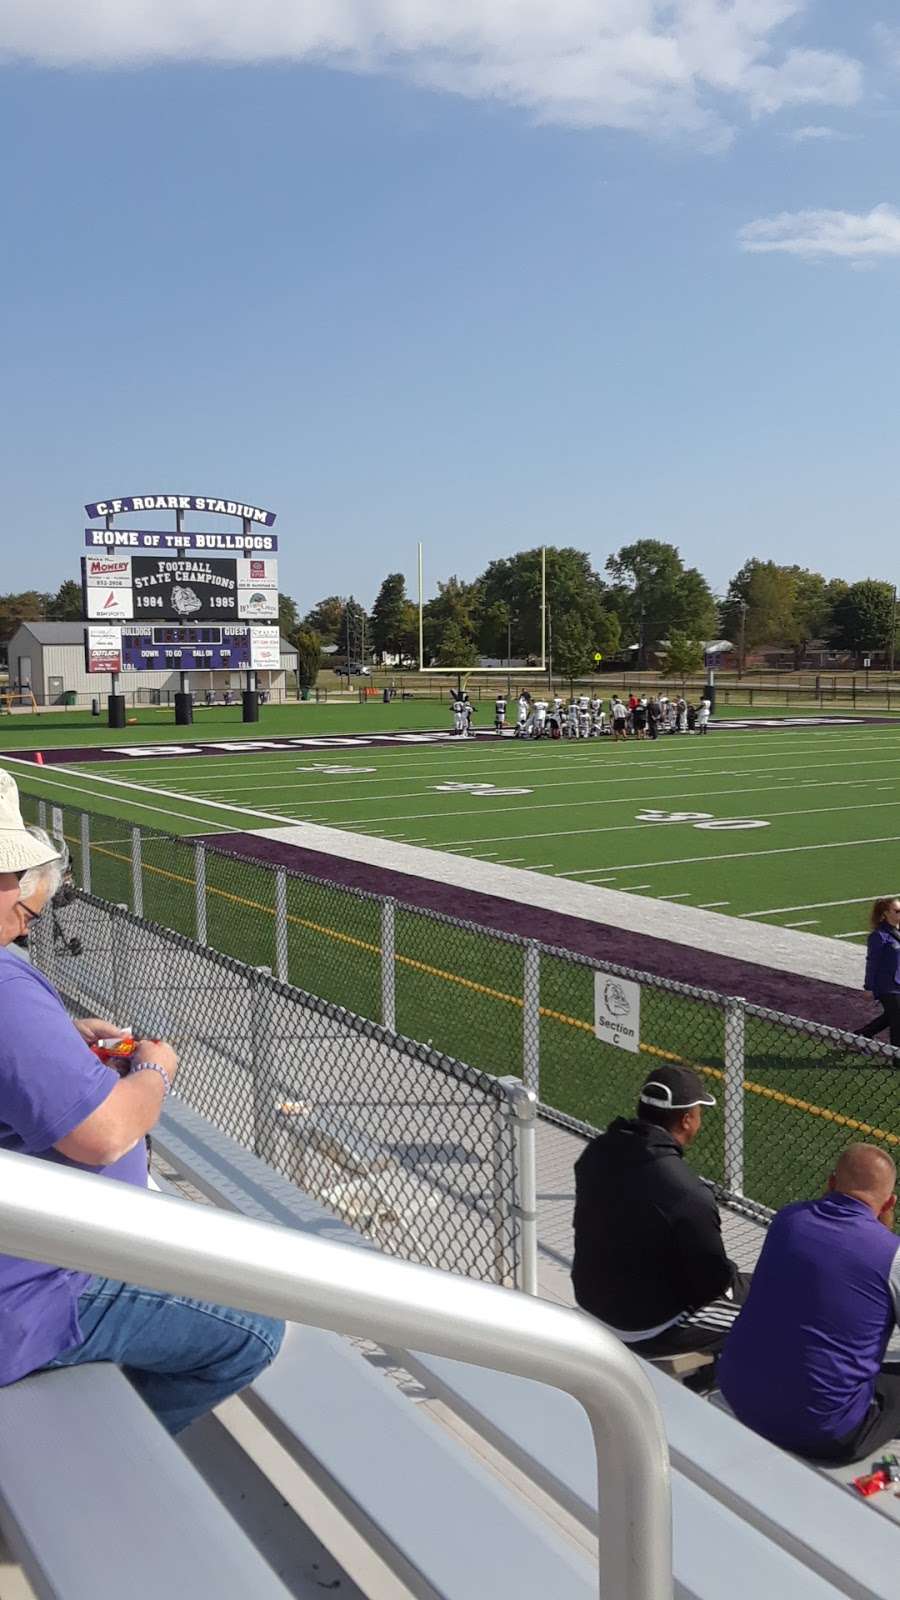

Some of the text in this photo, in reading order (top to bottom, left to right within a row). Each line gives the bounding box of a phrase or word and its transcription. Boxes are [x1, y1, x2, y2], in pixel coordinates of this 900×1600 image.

[96, 496, 267, 523] C.F. ROARK STADIUM
[92, 531, 272, 549] HOME OF THE BULLDOGS
[158, 561, 212, 573] FOOTBALL
[134, 572, 171, 588] STATE
[175, 571, 235, 590] CHAMPIONS
[136, 596, 163, 608] 1984
[210, 597, 235, 608] 1985
[122, 627, 152, 636] BULLDOGS
[224, 627, 248, 636] GUEST
[598, 1015, 635, 1037] Section
[612, 1033, 620, 1044] C
